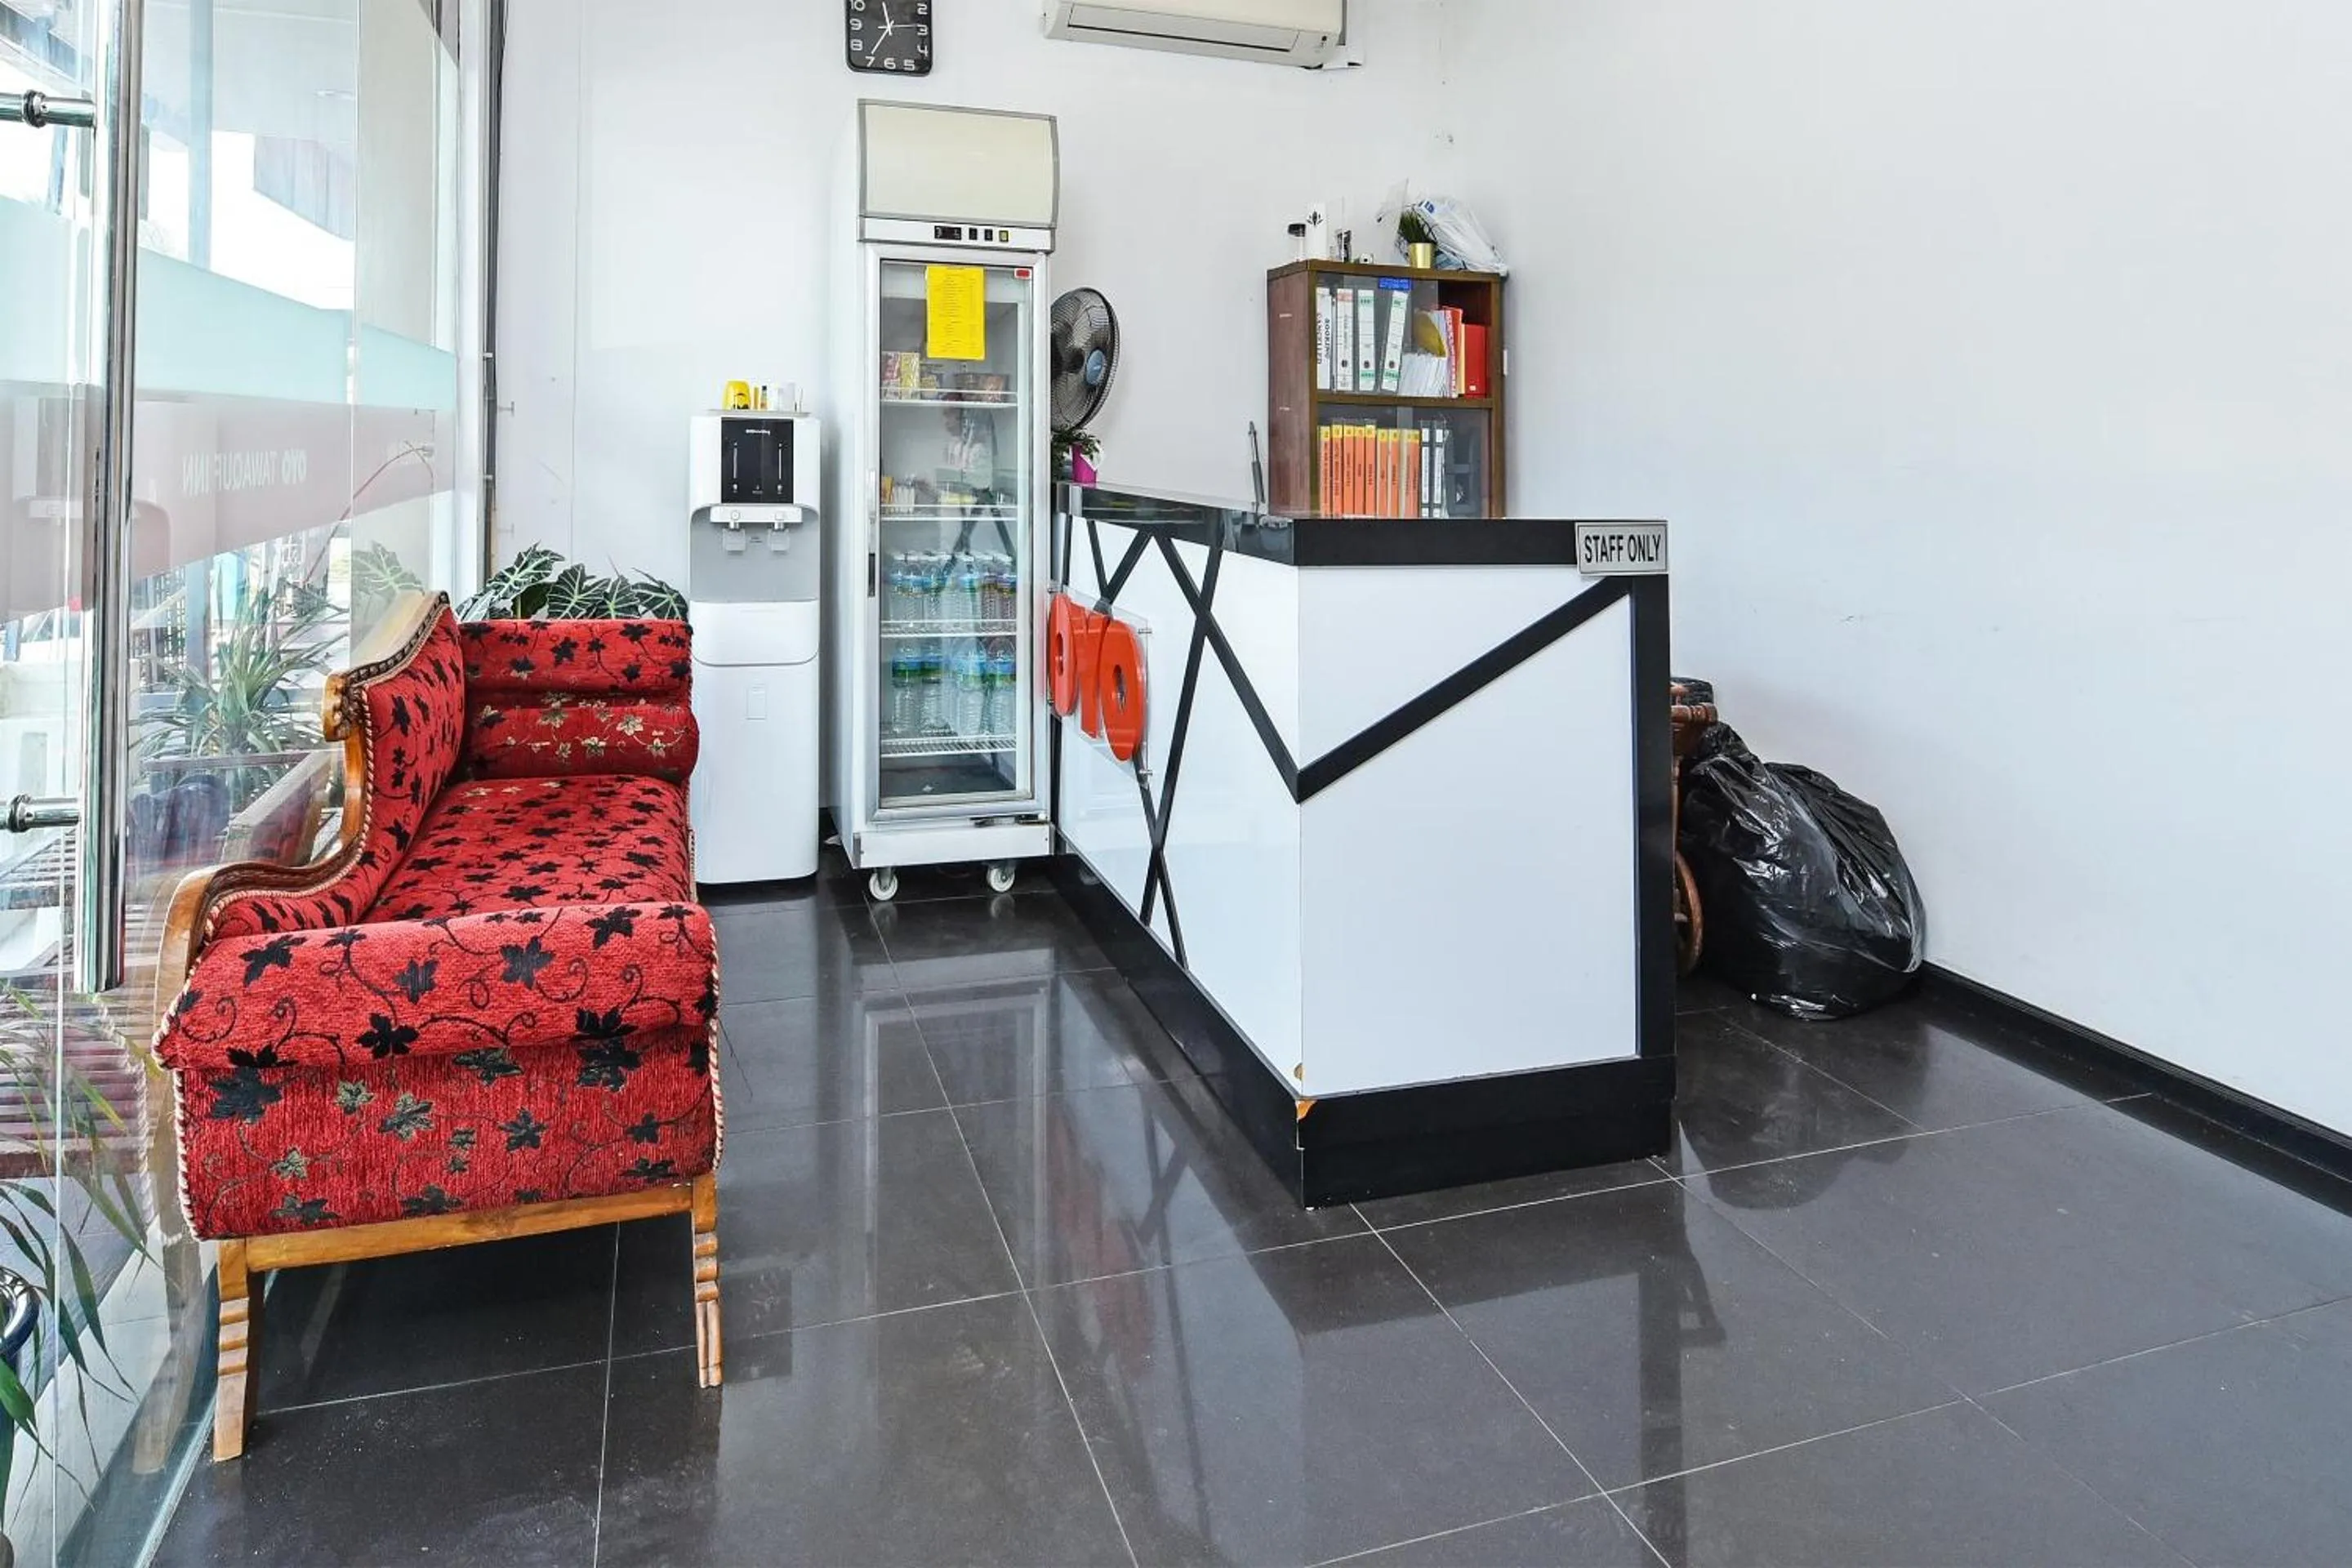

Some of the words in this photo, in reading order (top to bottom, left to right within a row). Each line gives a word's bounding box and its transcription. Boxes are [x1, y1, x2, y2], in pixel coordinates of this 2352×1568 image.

[850, 0, 866, 11] 10
[917, 3, 928, 15] 2
[849, 19, 862, 30] 9
[917, 24, 928, 35] 3
[850, 39, 862, 51] 8
[917, 45, 929, 56] 4
[865, 56, 875, 67] 7
[884, 57, 896, 69] 6
[903, 59, 915, 70] 5
[1584, 534, 1624, 564] STAFF
[1627, 533, 1661, 563] ONLY
[1049, 593, 1144, 761] OYO
